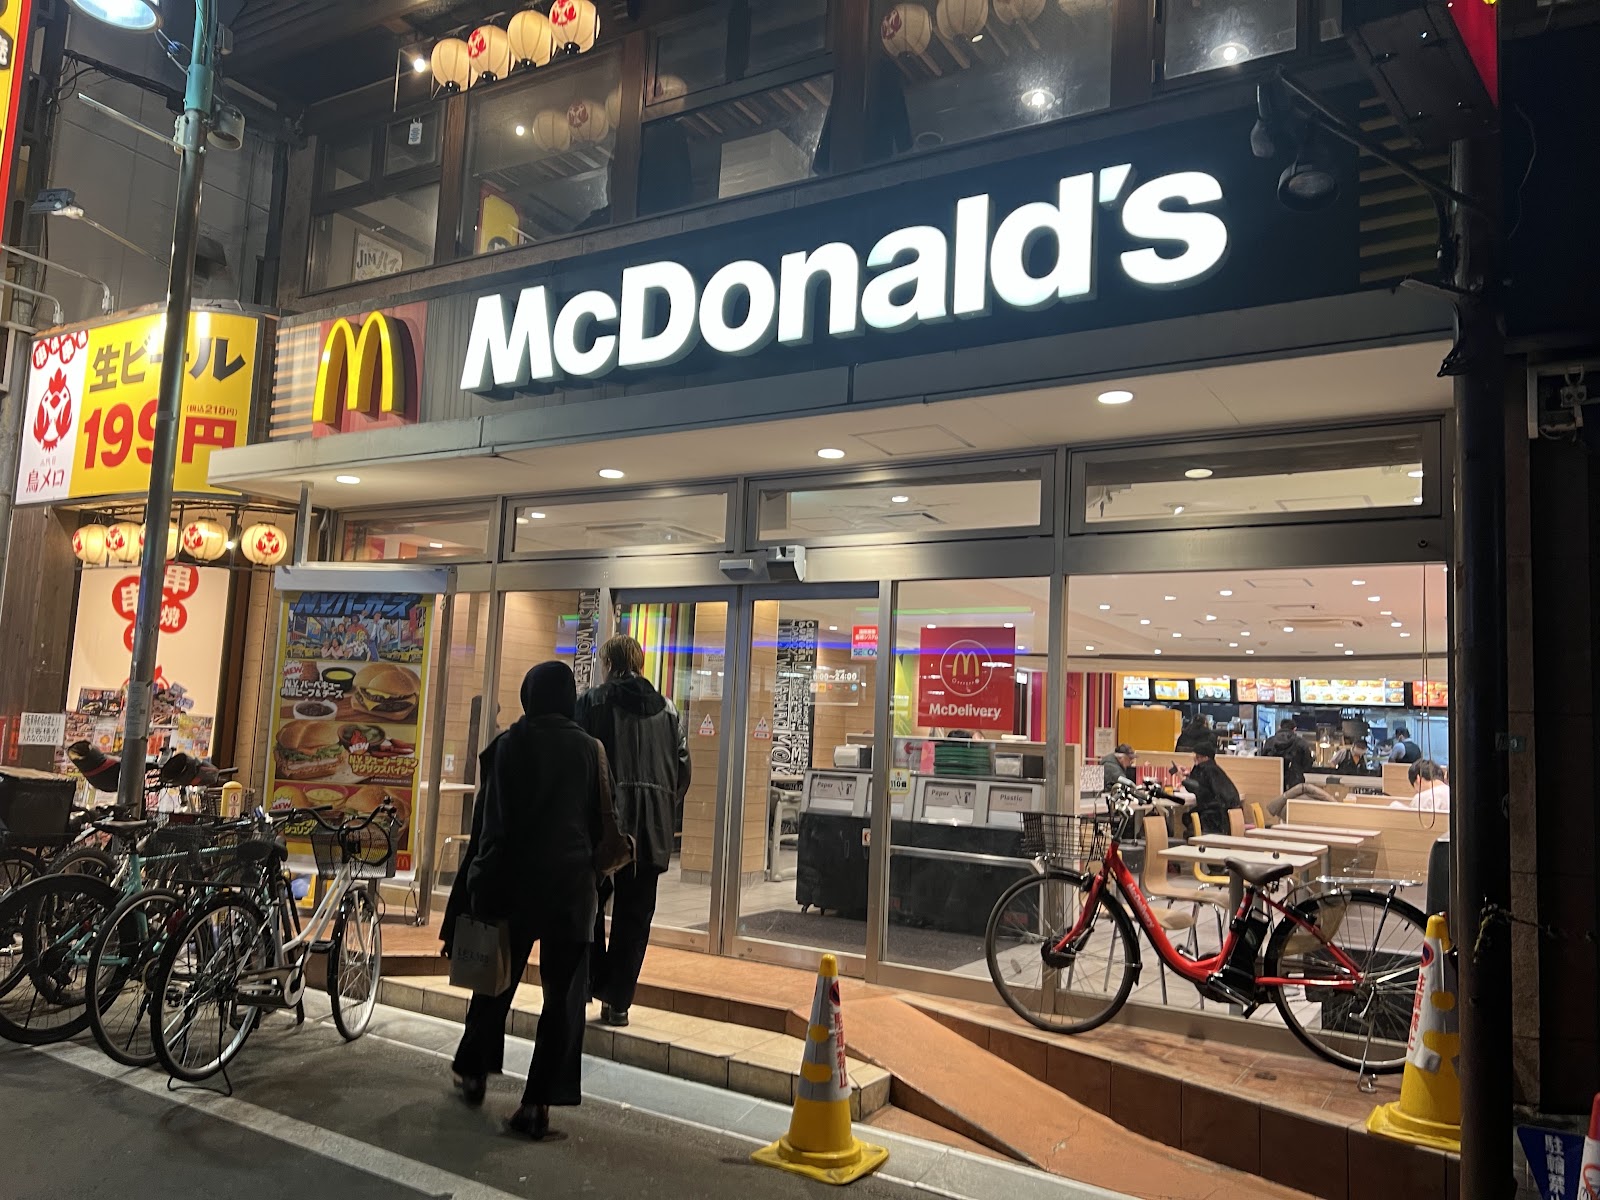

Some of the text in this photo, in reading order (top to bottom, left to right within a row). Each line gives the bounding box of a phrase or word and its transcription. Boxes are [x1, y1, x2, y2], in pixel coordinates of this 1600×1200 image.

[356, 249, 376, 269] JIM
[460, 162, 1227, 391] McDonald's
[25, 468, 65, 493] 鳥メロ
[929, 703, 1002, 721] McDelivery
[817, 781, 834, 789] Paper
[931, 789, 950, 797] Paper
[1000, 793, 1023, 802] Plastic
[1126, 882, 1155, 929] McDelivery
